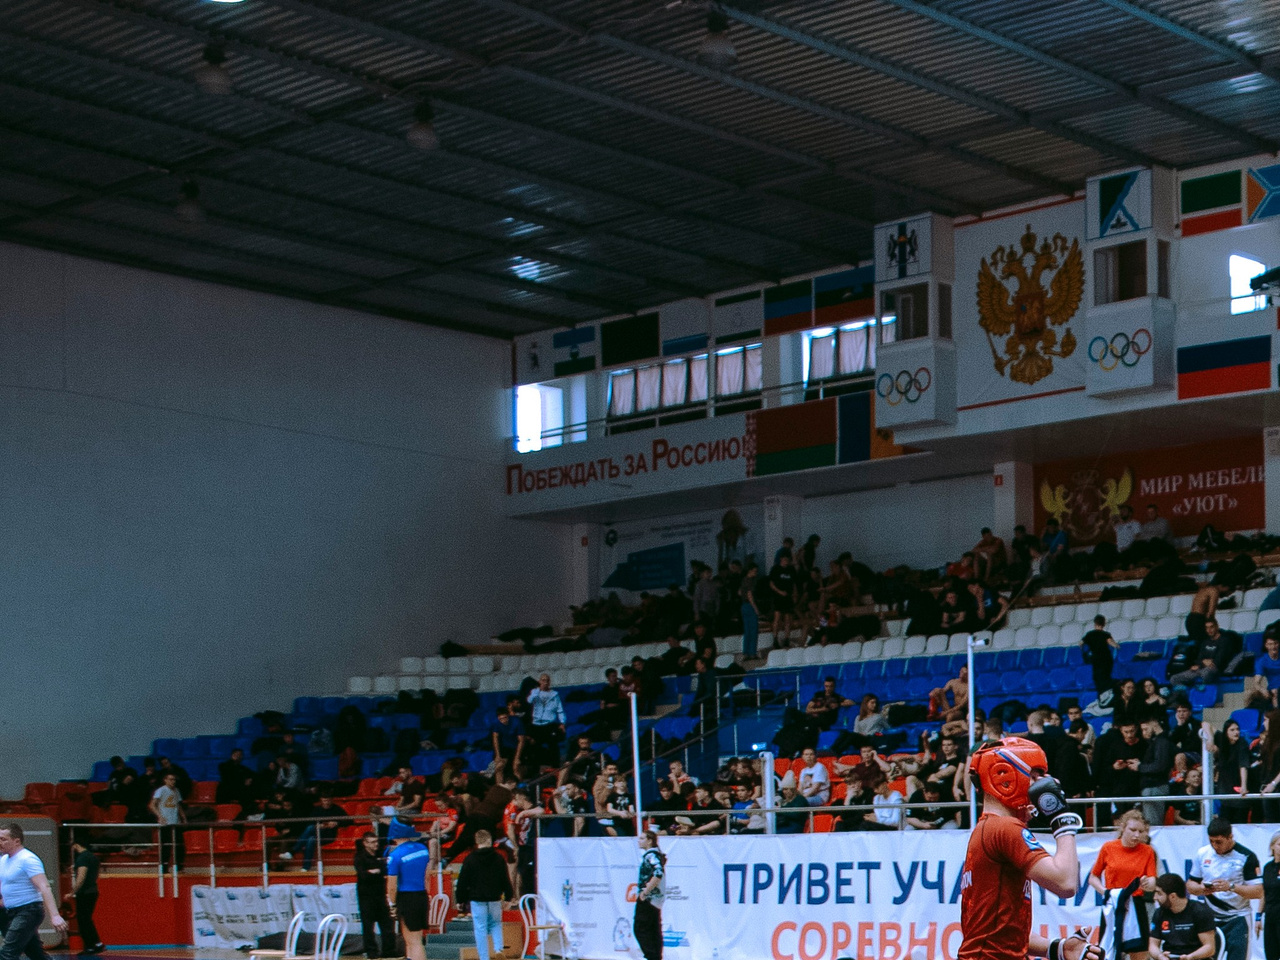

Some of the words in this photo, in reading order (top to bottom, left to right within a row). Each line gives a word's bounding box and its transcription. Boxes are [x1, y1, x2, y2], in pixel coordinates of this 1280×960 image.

[1140, 474, 1184, 497] МИР
[1172, 493, 1239, 517] «УЮТ»
[723, 860, 882, 905] ПРИВЕТ
